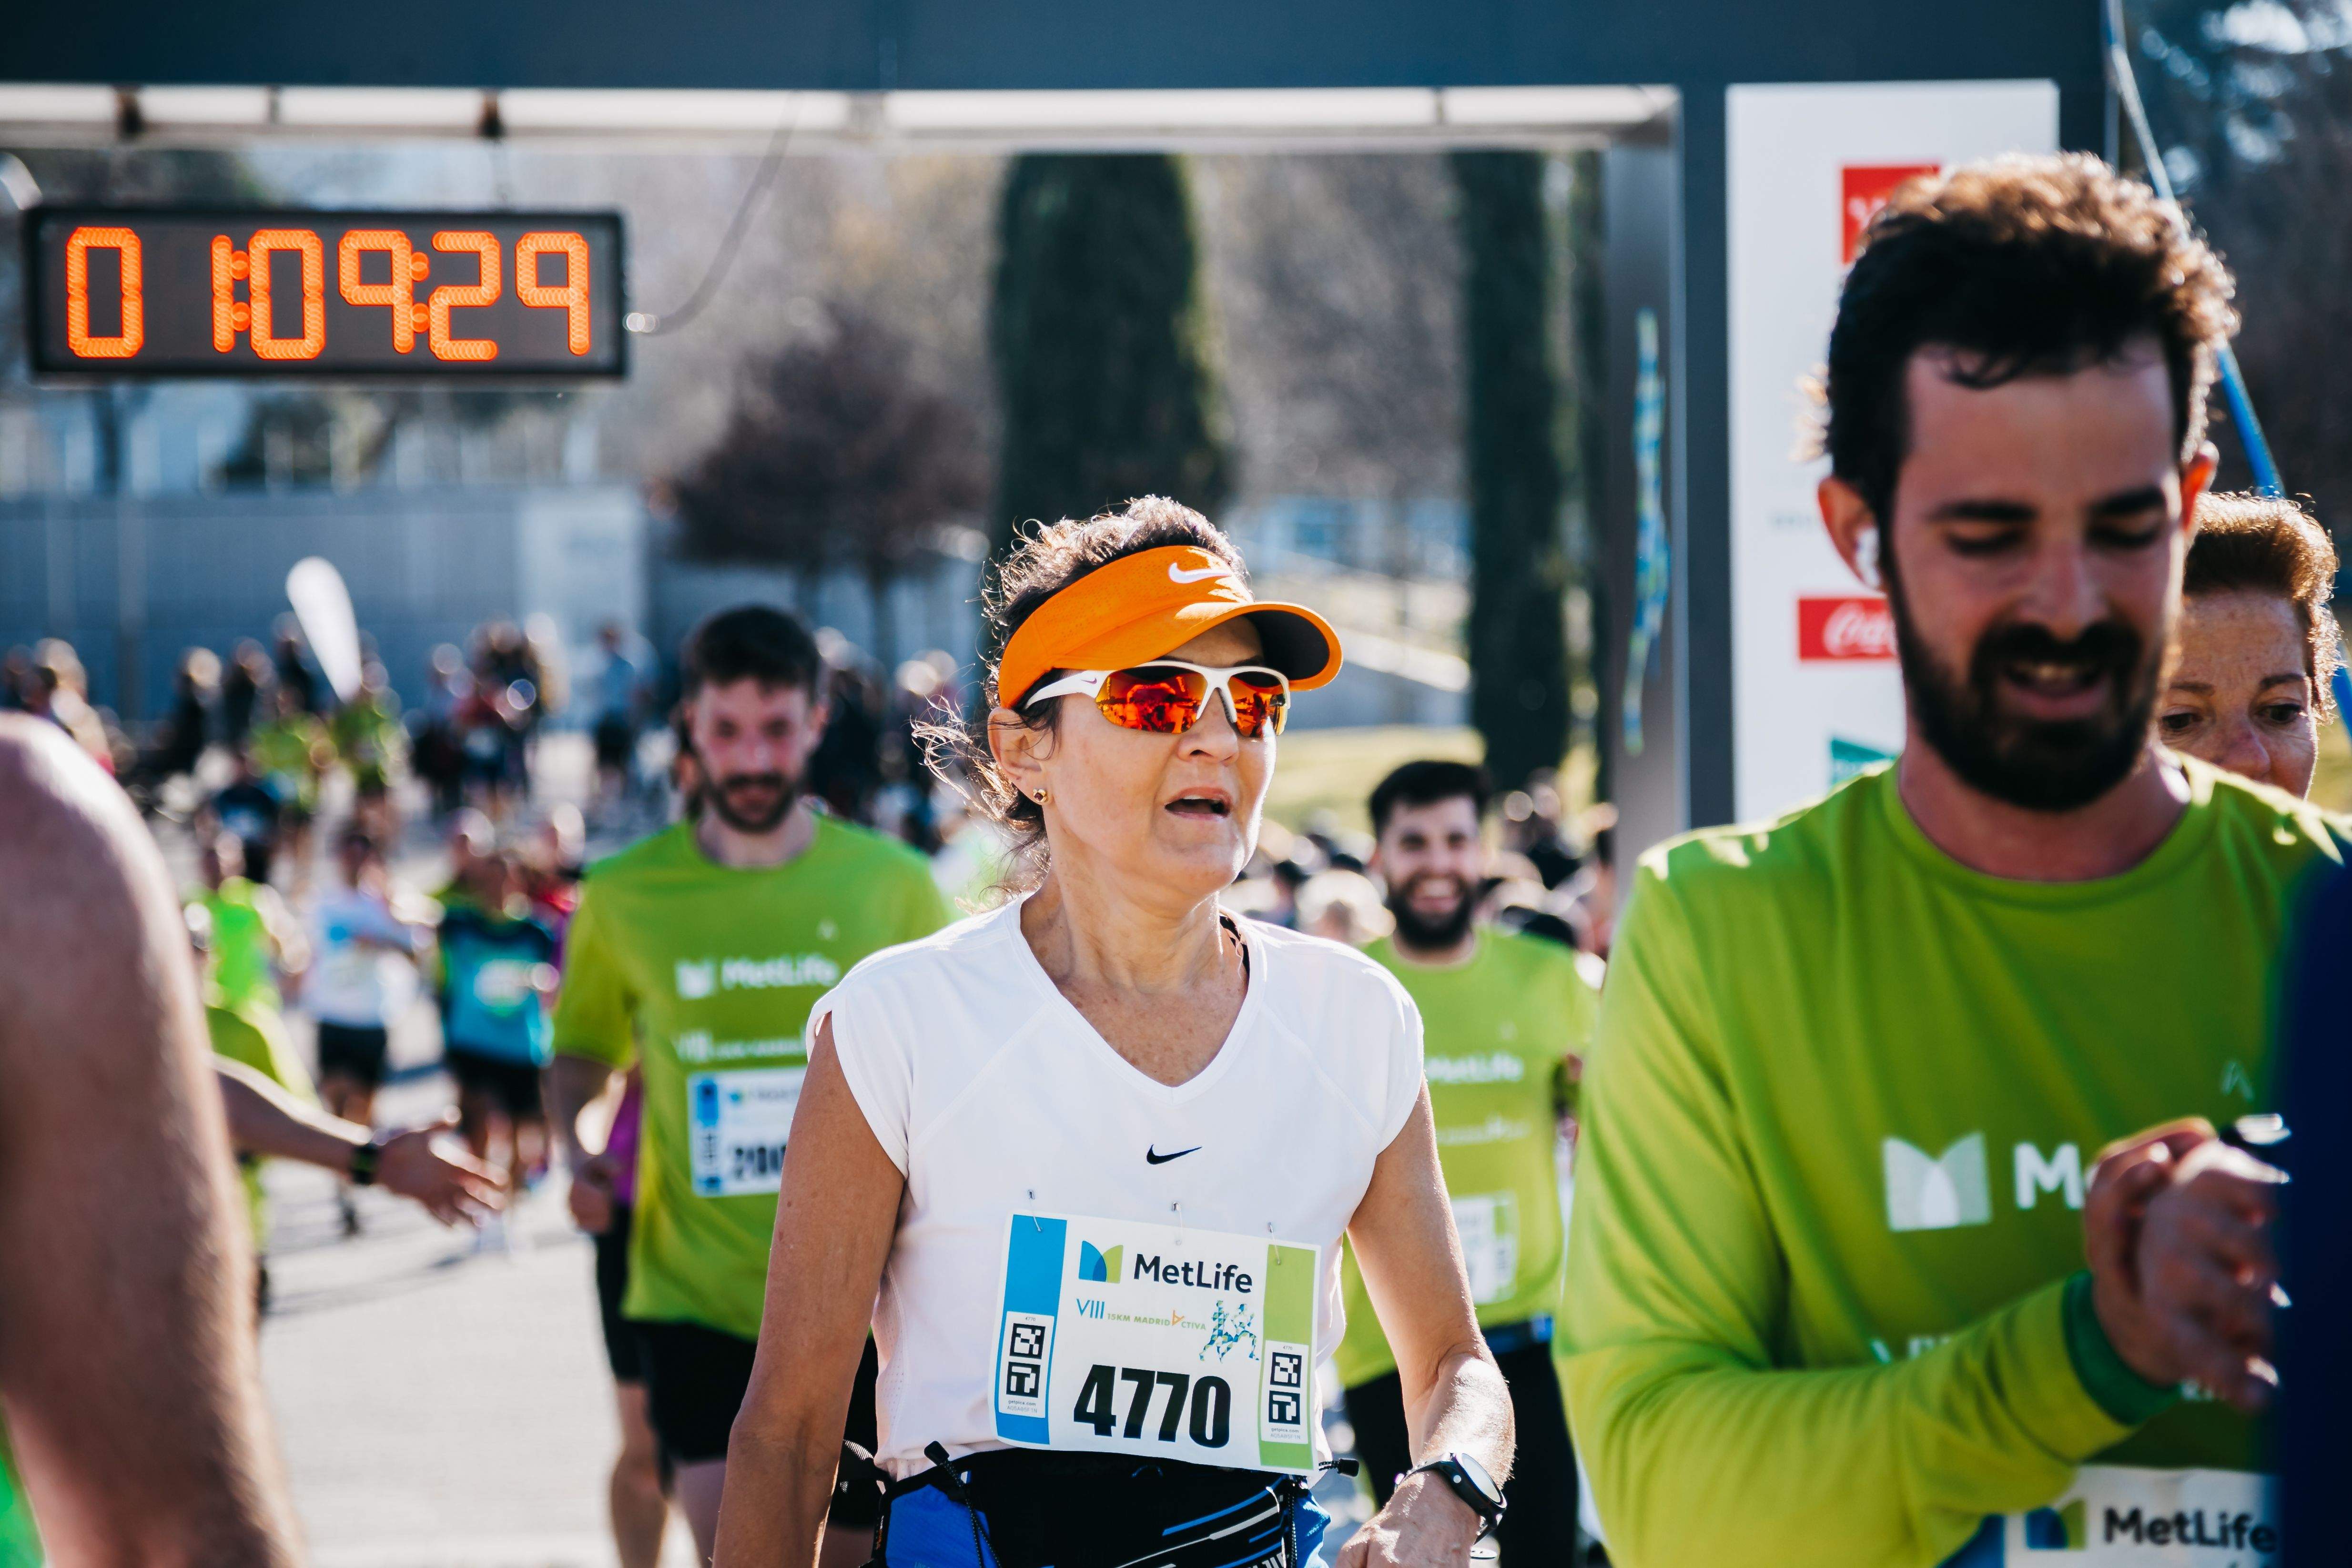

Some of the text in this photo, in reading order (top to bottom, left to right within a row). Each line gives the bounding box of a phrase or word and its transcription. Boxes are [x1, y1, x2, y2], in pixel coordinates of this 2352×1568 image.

[67, 226, 143, 358] 0
[1134, 1253, 1252, 1293] MetLife
[1076, 1298, 1105, 1319] VIII
[1107, 1313, 1131, 1322] 15KM
[1134, 1316, 1170, 1326] MADRID
[1074, 1364, 1231, 1448] 4770
[2103, 1506, 2277, 1554] MetLife
